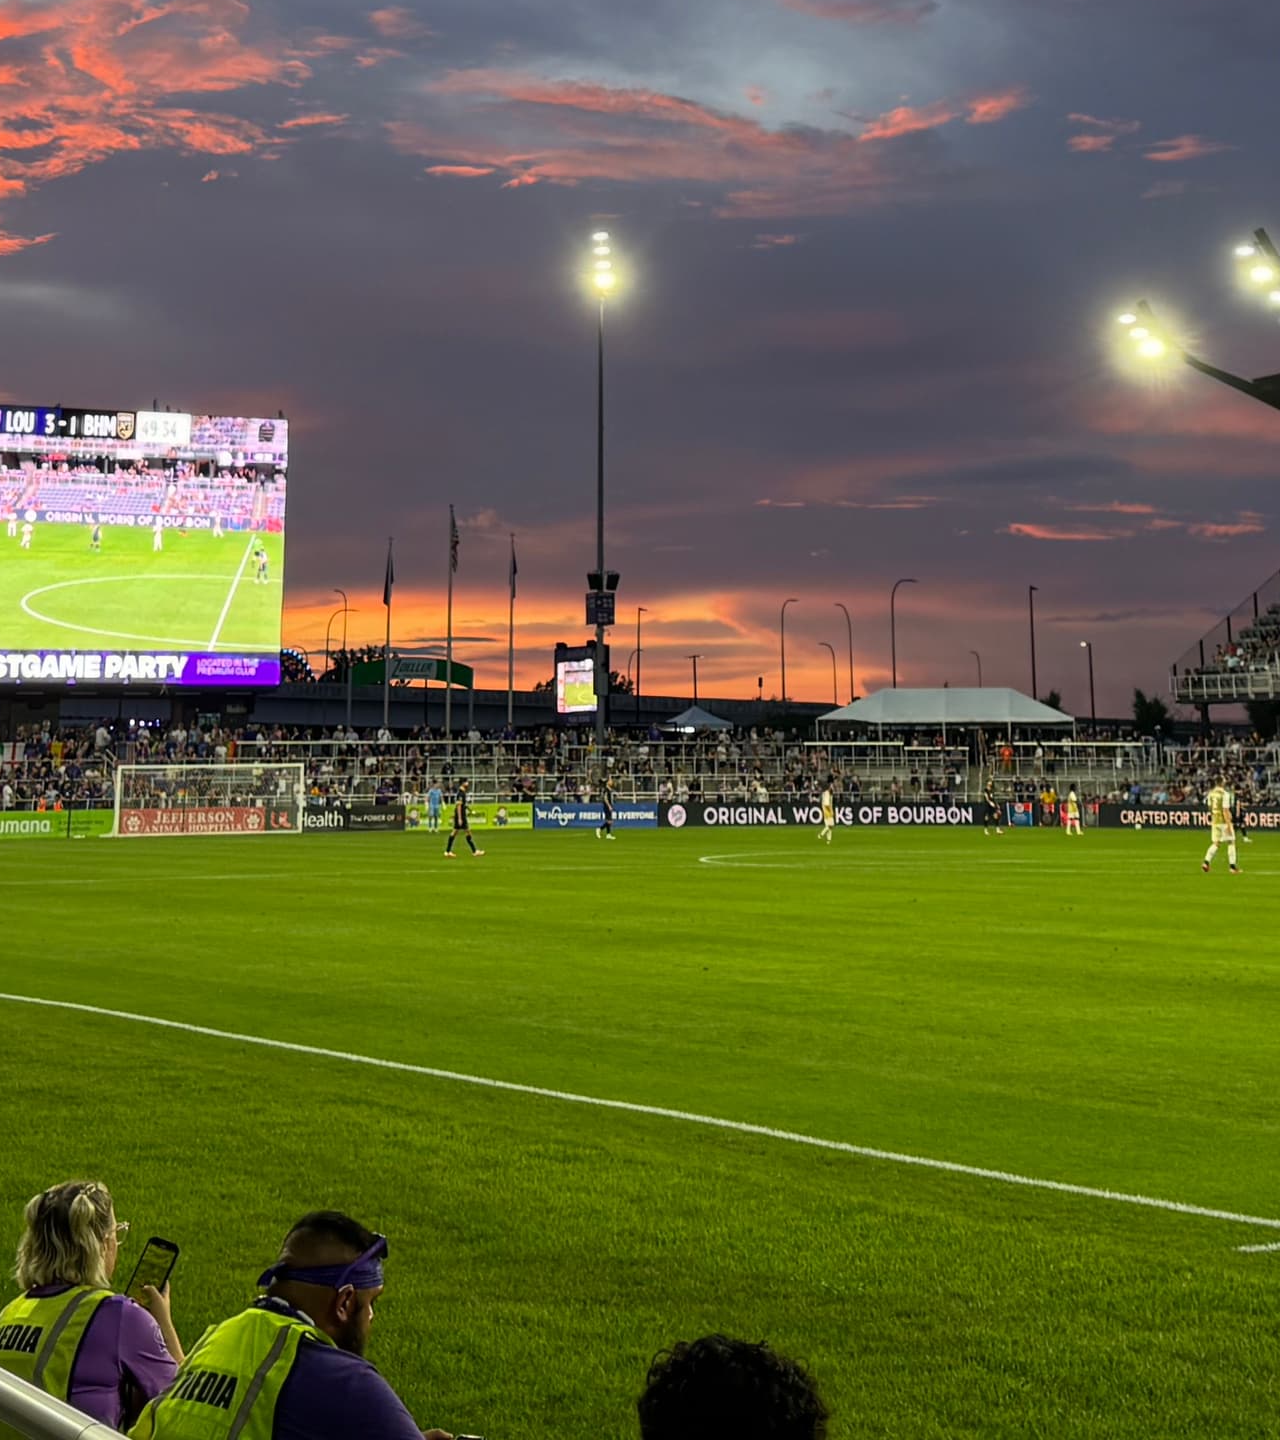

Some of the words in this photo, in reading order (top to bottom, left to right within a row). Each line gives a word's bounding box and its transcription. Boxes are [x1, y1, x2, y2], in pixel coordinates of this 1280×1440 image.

[5, 410, 35, 432] LOU
[44, 413, 55, 435] 3
[84, 414, 117, 436] BHM
[104, 655, 189, 679] PARTY
[235, 667, 257, 676] CLUB
[154, 811, 235, 825] JEFFERSON
[300, 810, 344, 827] Health
[548, 806, 576, 826] Kroger
[703, 807, 787, 825] ORIGINAL
[793, 806, 853, 825] WOKS
[859, 807, 882, 824] OF
[888, 807, 973, 825] BOURBON
[1120, 810, 1168, 825] CRAFTED
[1170, 811, 1191, 825] FOR
